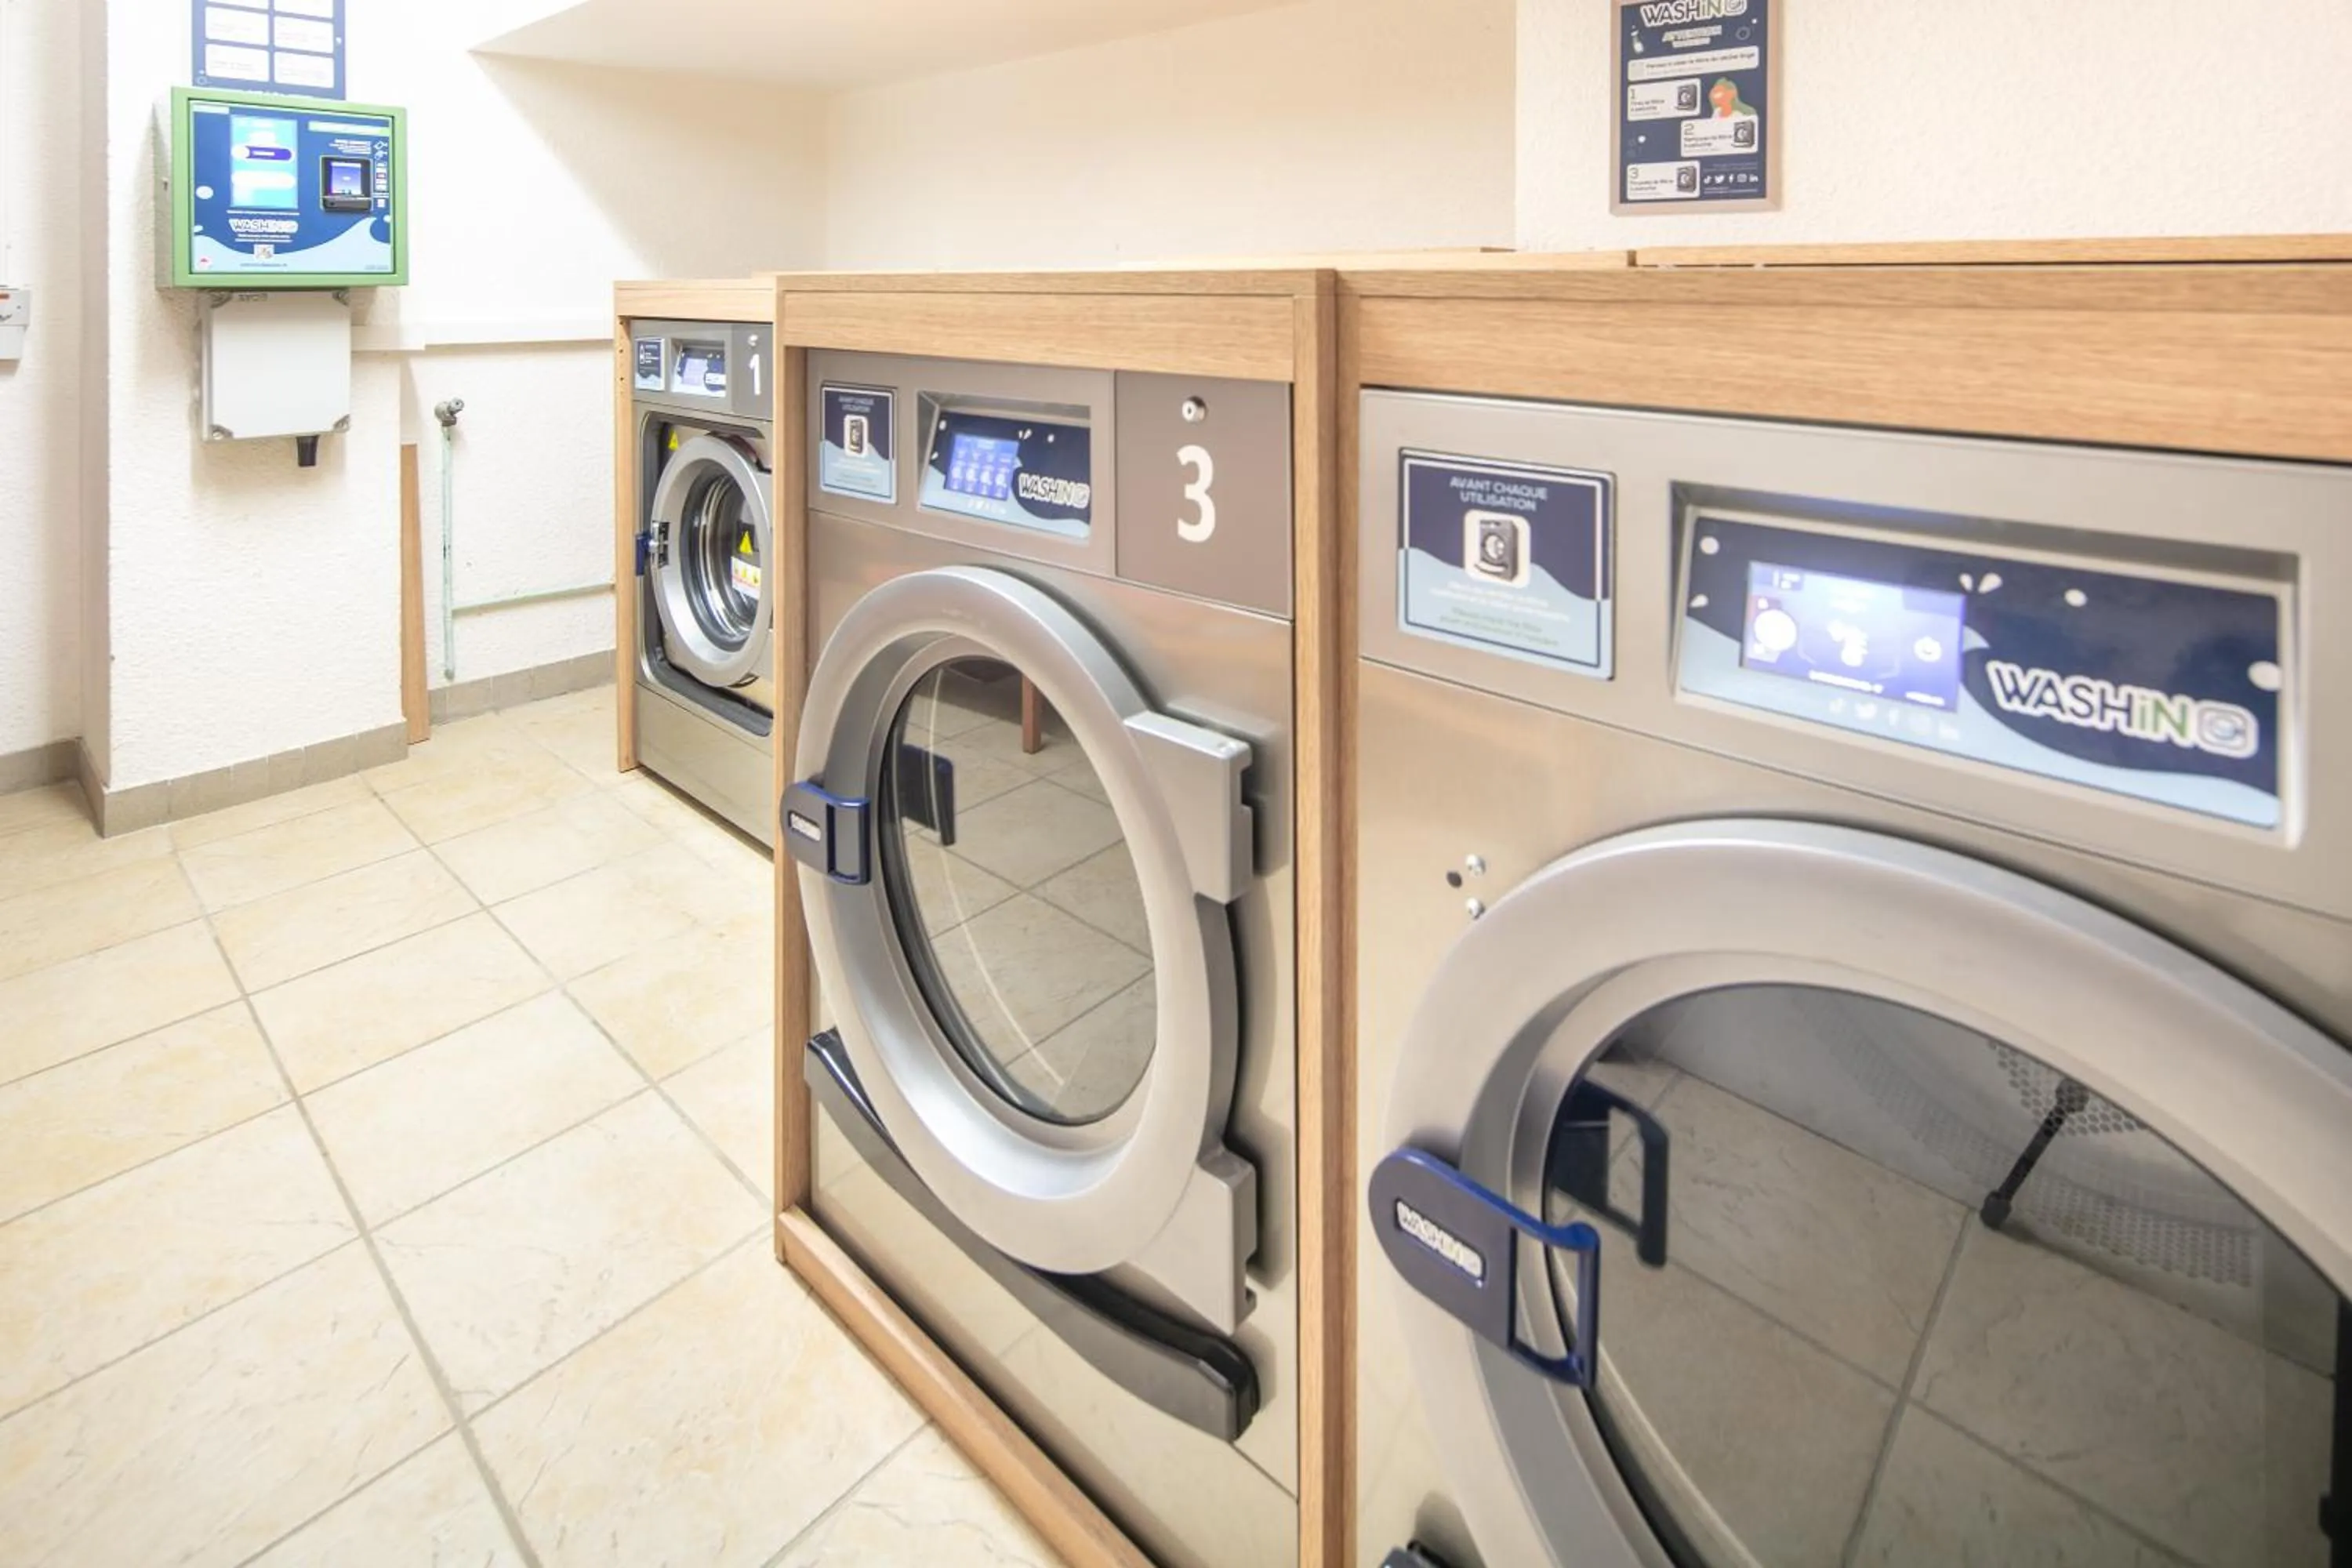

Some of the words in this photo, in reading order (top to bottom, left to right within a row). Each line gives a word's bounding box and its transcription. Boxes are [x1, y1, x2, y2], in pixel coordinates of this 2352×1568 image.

[1684, 123, 1694, 136] 2
[1629, 167, 1639, 180] 3
[748, 353, 761, 396] 1
[1176, 444, 1216, 543] 3
[1450, 476, 1490, 492] AVANT
[1492, 481, 1548, 501] CHAQUE
[1459, 490, 1537, 512] UTILISATION
